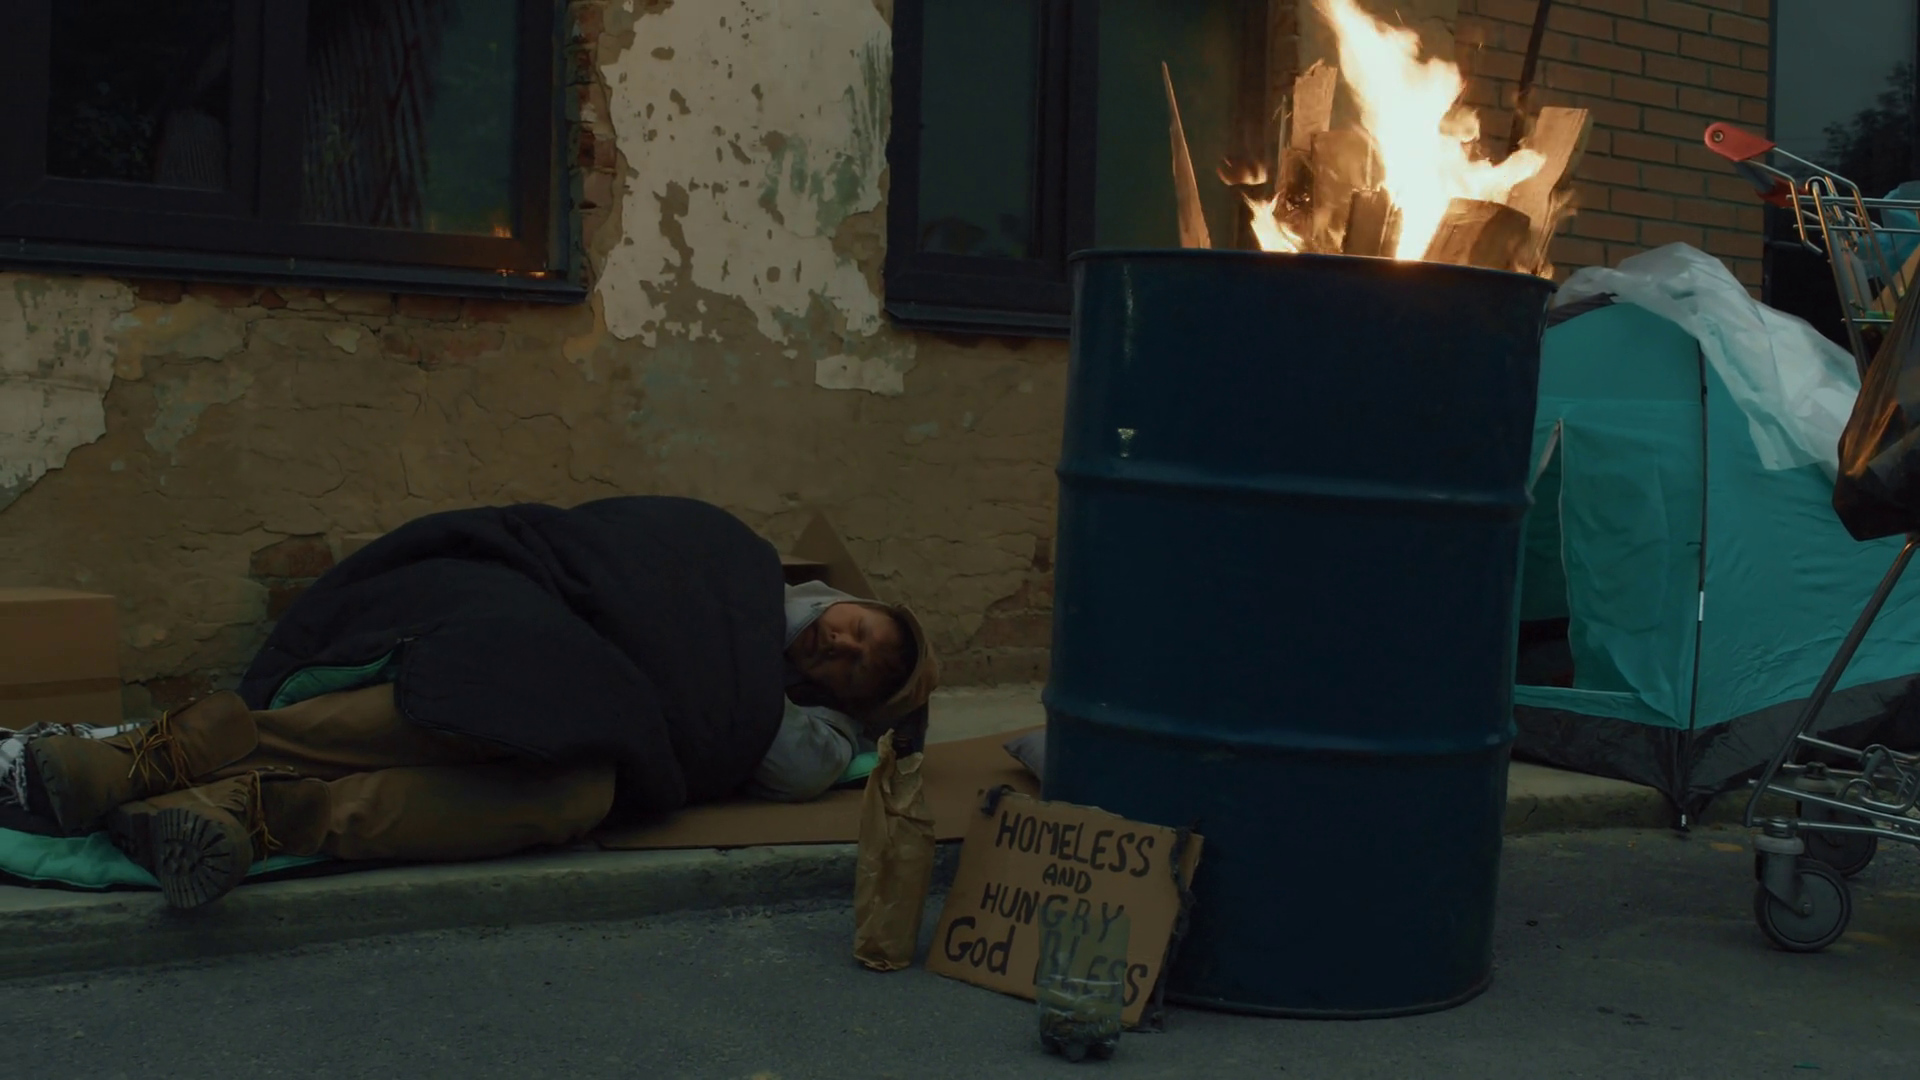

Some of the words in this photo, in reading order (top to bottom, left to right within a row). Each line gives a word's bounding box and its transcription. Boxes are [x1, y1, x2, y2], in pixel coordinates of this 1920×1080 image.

[996, 811, 1154, 877] HOMELESS
[1042, 864, 1092, 894] AND
[980, 882, 1124, 942] HUNGRY
[944, 916, 1016, 975] God
